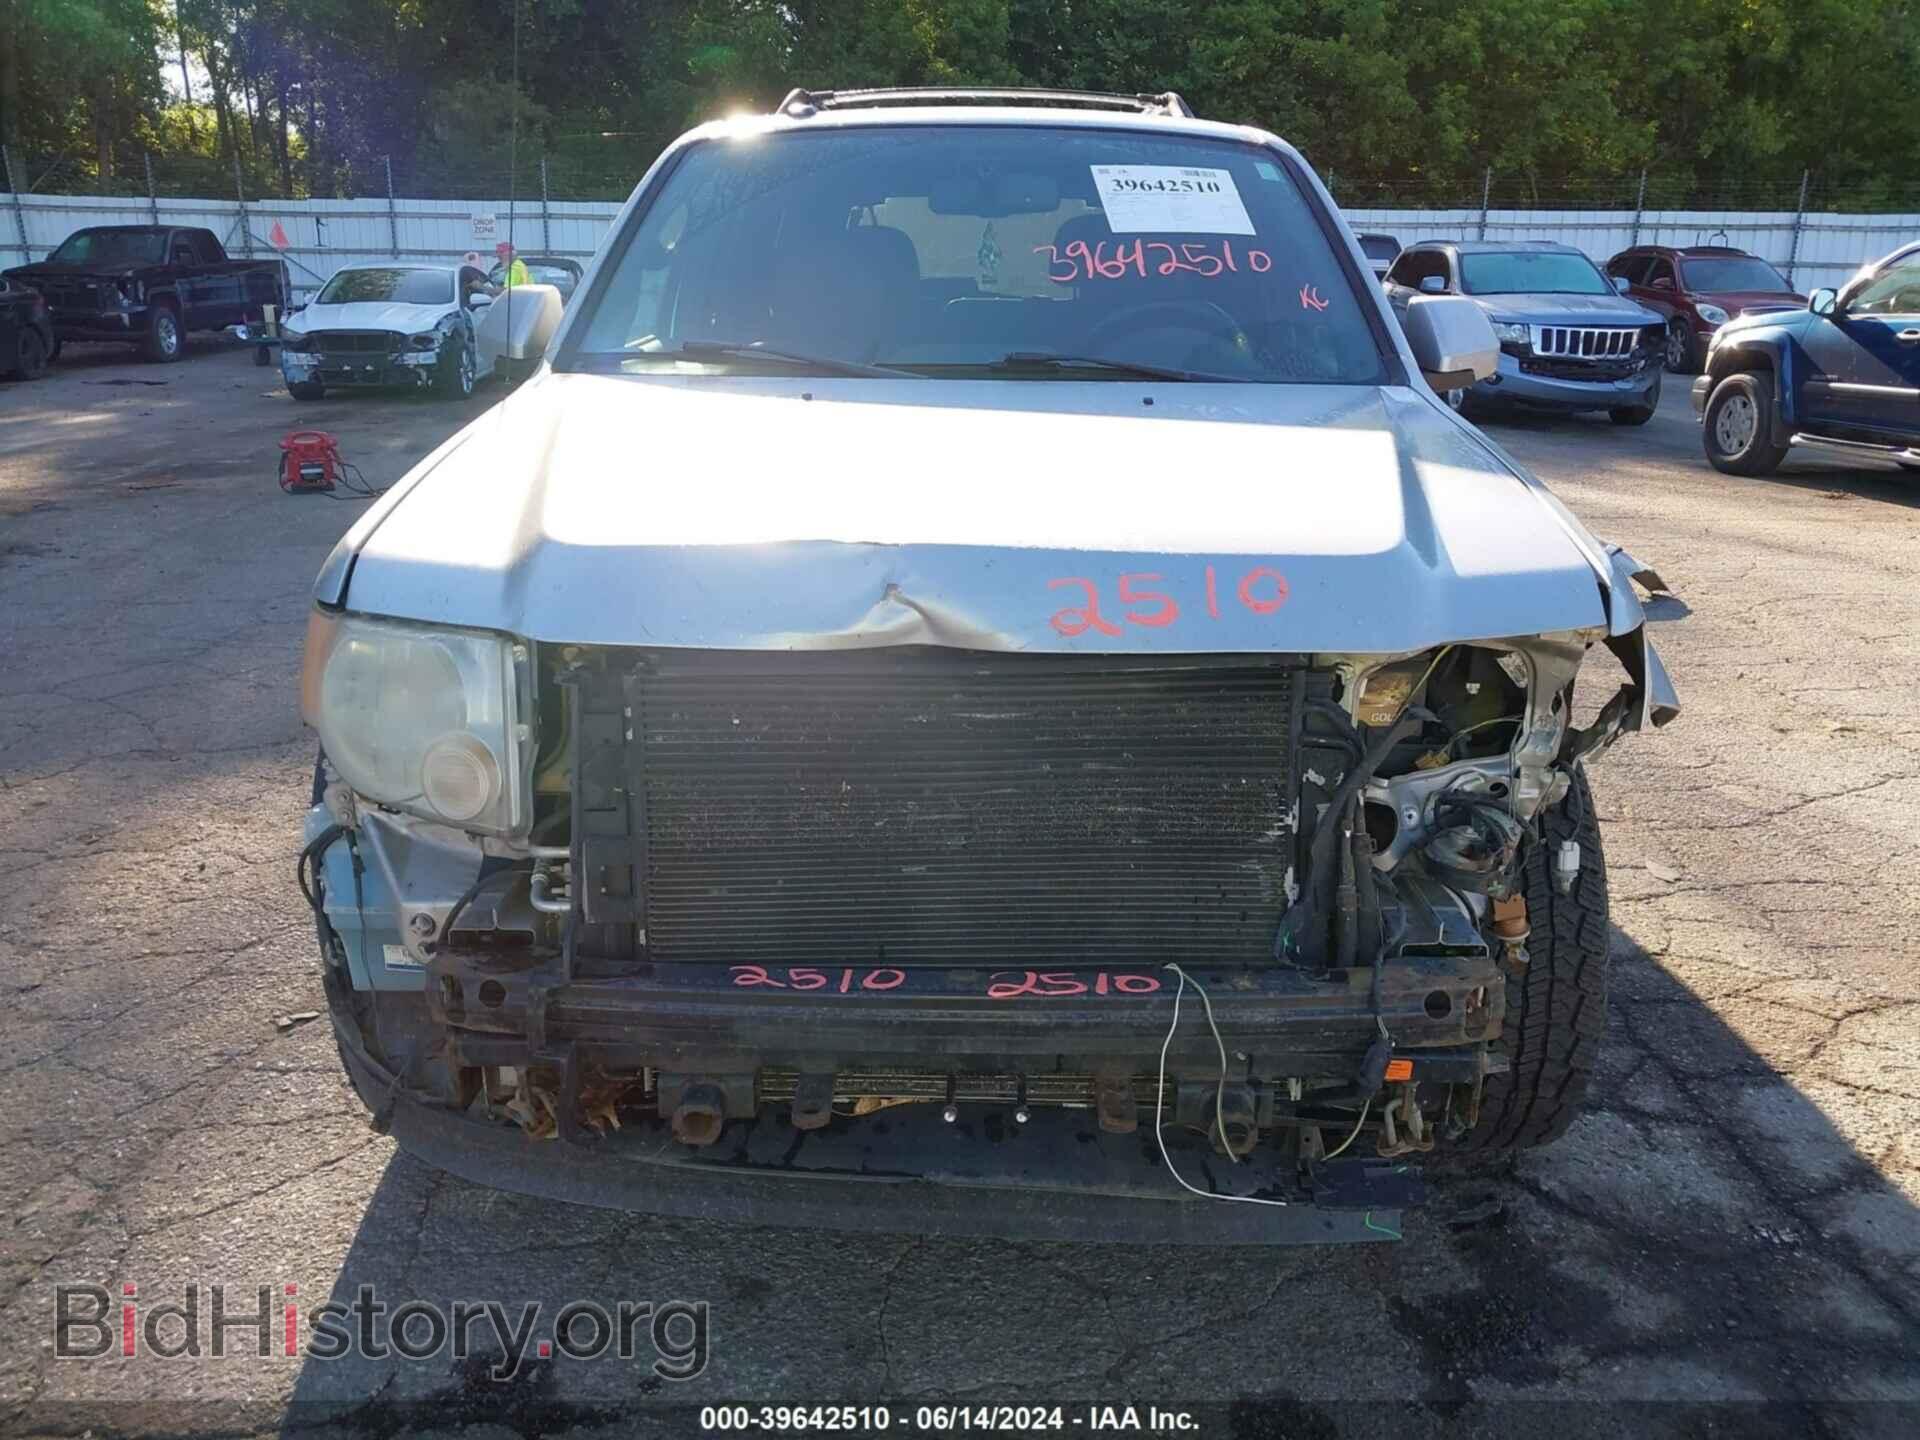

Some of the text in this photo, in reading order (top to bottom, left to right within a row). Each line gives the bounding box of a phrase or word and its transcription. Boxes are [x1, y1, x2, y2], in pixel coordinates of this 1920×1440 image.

[1112, 178, 1220, 193] 39642510
[1034, 239, 1271, 281] 39642510
[1048, 564, 1288, 637] 2510
[730, 966, 1159, 998] 2510 2510
